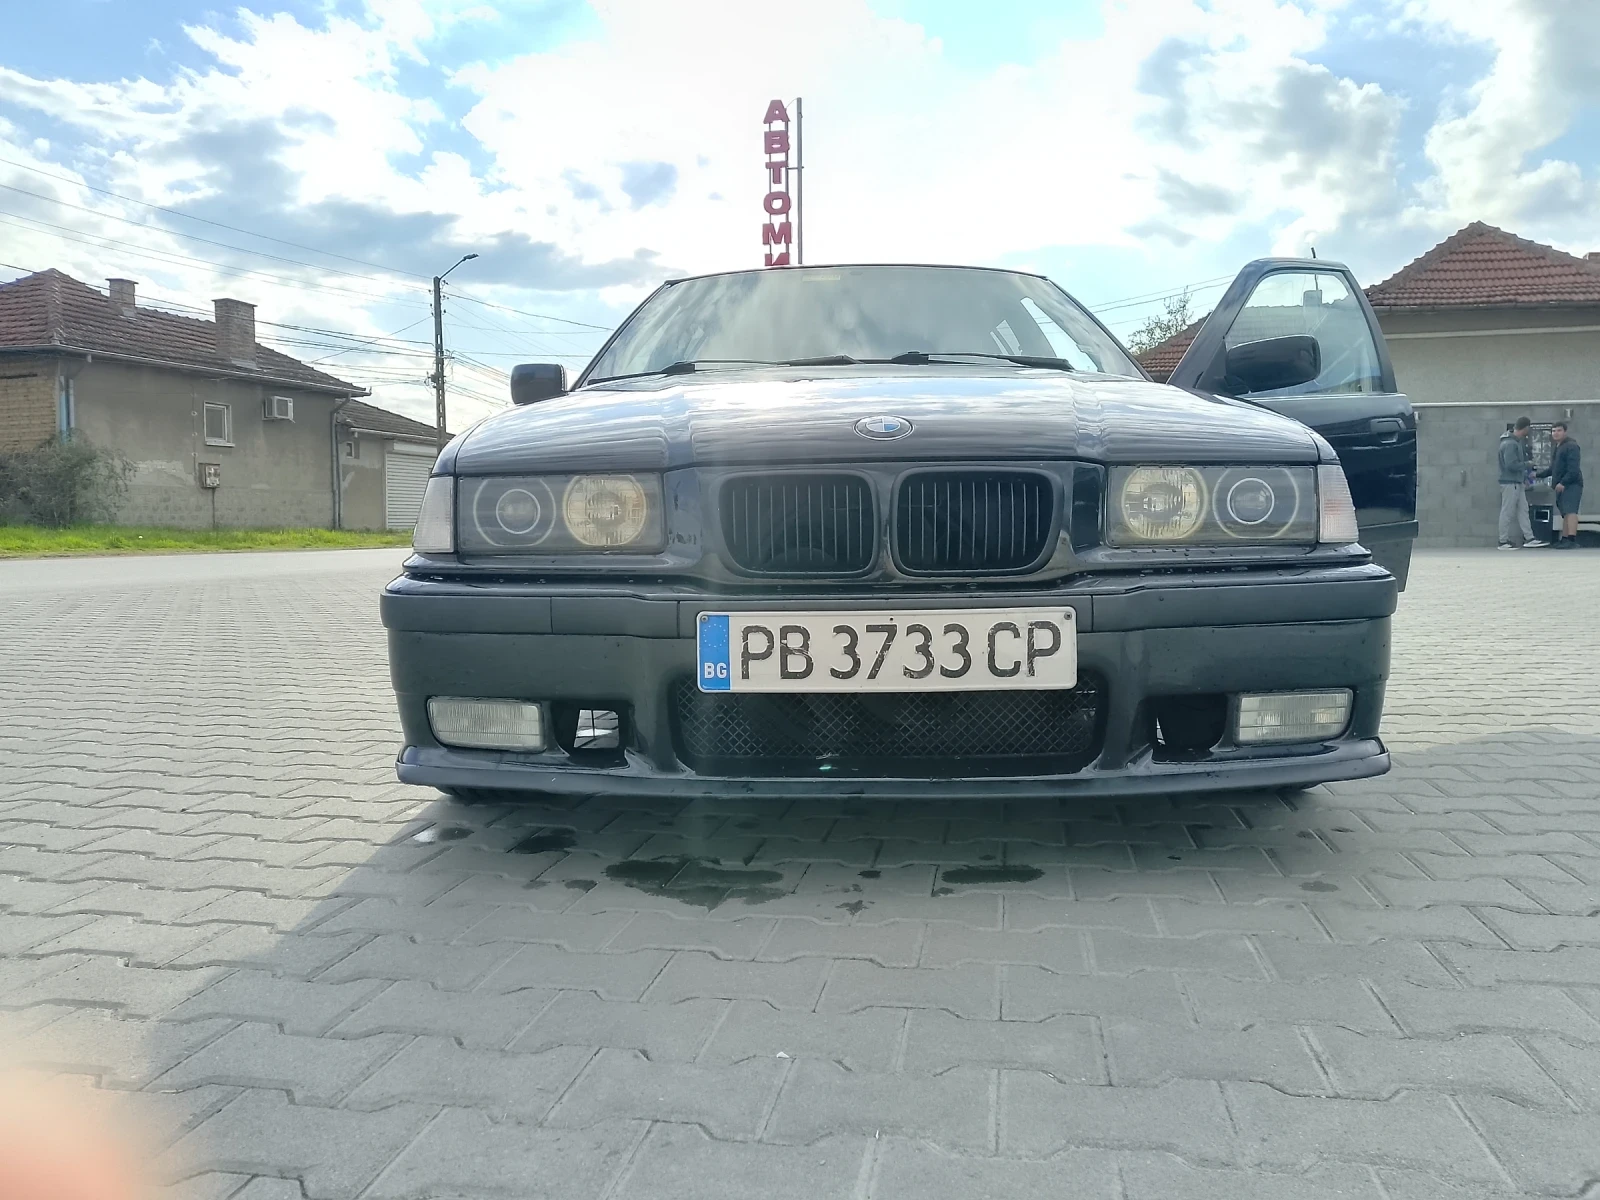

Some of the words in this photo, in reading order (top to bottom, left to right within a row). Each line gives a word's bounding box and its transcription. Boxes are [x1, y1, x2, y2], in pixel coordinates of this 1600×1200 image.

[741, 624, 814, 680] PB
[829, 621, 972, 680] 3733
[987, 620, 1062, 678] CP
[704, 662, 727, 679] BG
